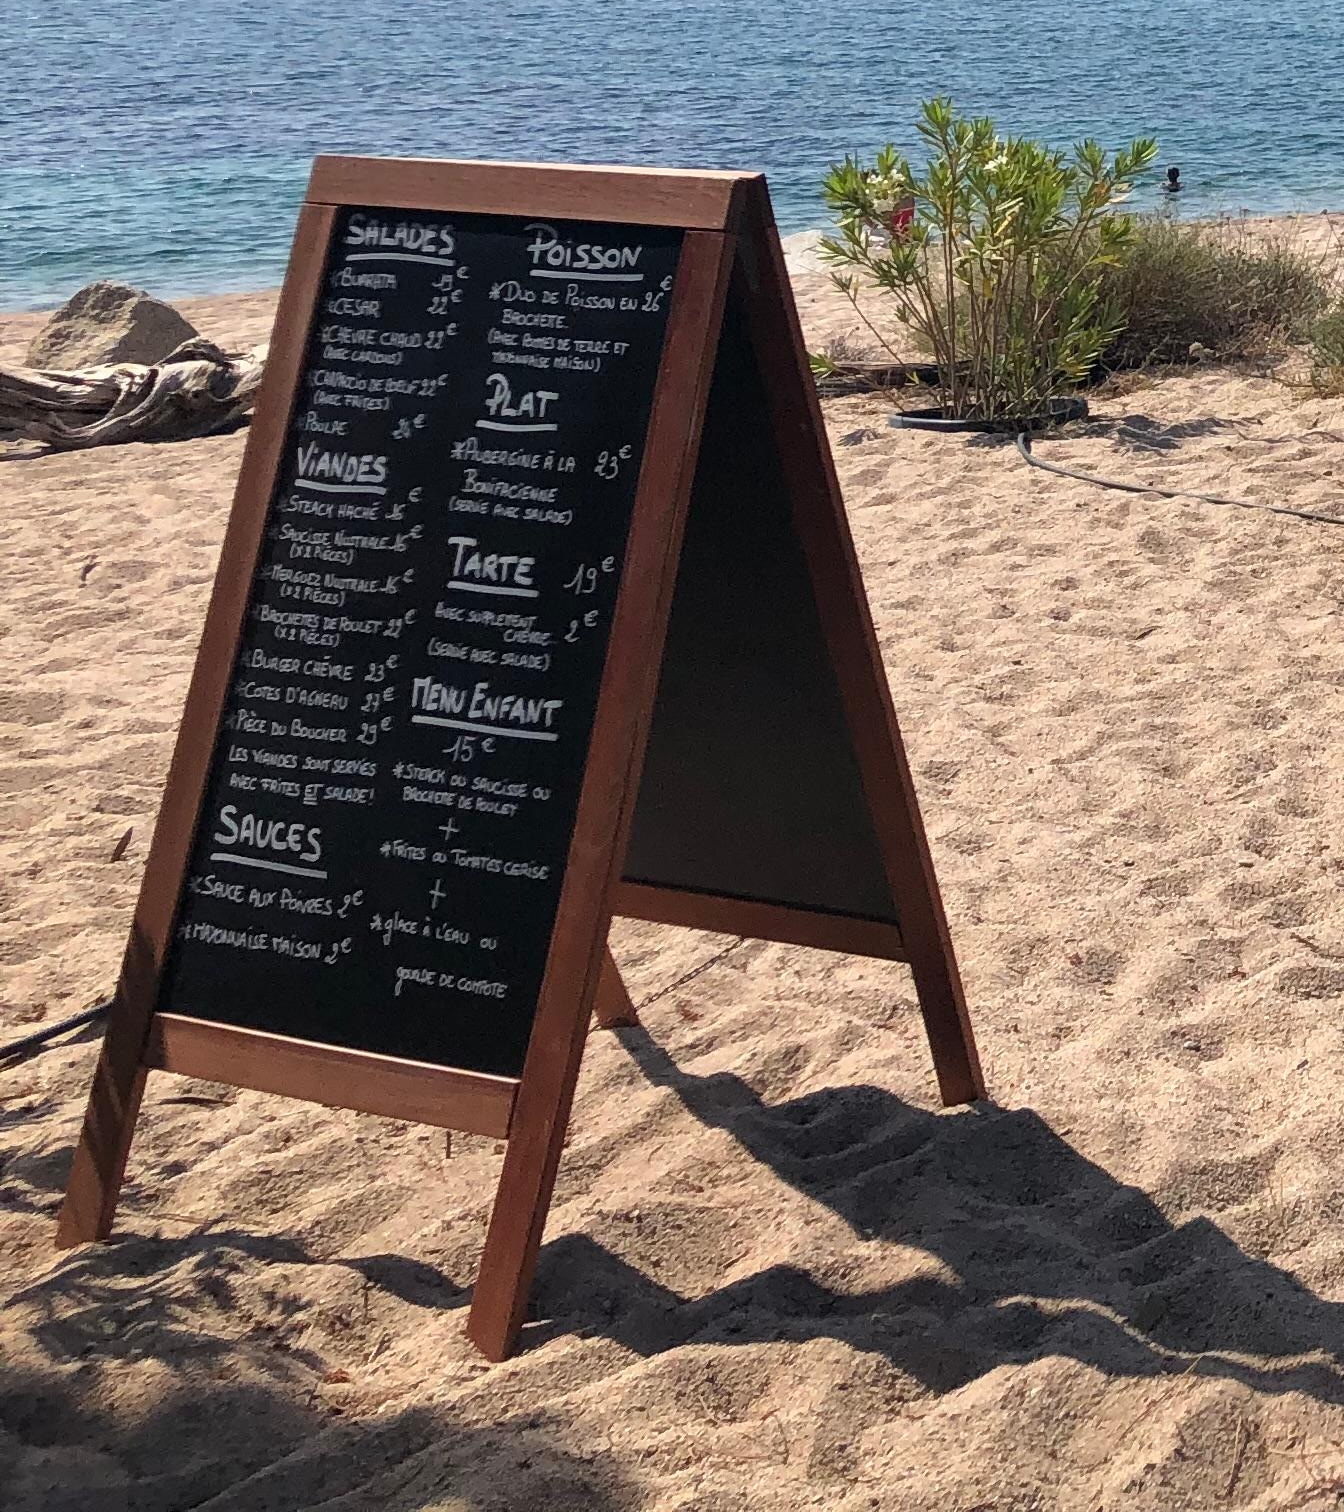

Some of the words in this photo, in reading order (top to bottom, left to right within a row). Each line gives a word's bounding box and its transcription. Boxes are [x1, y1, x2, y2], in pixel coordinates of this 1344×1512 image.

[346, 214, 456, 255] SALADES
[502, 281, 537, 302] DUO
[542, 291, 559, 304] DE
[620, 297, 638, 311] EN
[613, 342, 630, 356] ET
[369, 378, 384, 392] DE
[485, 373, 560, 418] PLAT
[557, 456, 576, 473] LA
[448, 536, 536, 585] TARTE
[563, 555, 615, 595] 19€
[323, 617, 337, 630] DE
[339, 617, 382, 633] POULET
[251, 649, 301, 673] BURGER
[411, 676, 468, 714] MENU
[468, 682, 563, 727] ENFANT
[271, 721, 287, 736] DU
[290, 718, 347, 742] BOUCHER
[228, 744, 249, 762] LES
[301, 756, 331, 771] SONT
[442, 736, 496, 762] 15€
[229, 773, 257, 790] AVEC
[303, 783, 324, 799] ET
[403, 763, 446, 784] STEACK
[450, 774, 467, 787] OU
[532, 787, 551, 800] OU
[458, 795, 474, 809] DE
[475, 797, 518, 817] POULET
[214, 804, 322, 863] SAUCES
[432, 851, 447, 863] OU
[450, 848, 501, 872] TOMATES
[200, 875, 244, 902] SAUCE
[249, 888, 278, 907] AUX
[337, 890, 364, 918] 2€
[324, 937, 353, 965] 2€
[479, 937, 497, 950] OU
[439, 973, 455, 988] DE
[457, 978, 508, 998] COMPOTE
